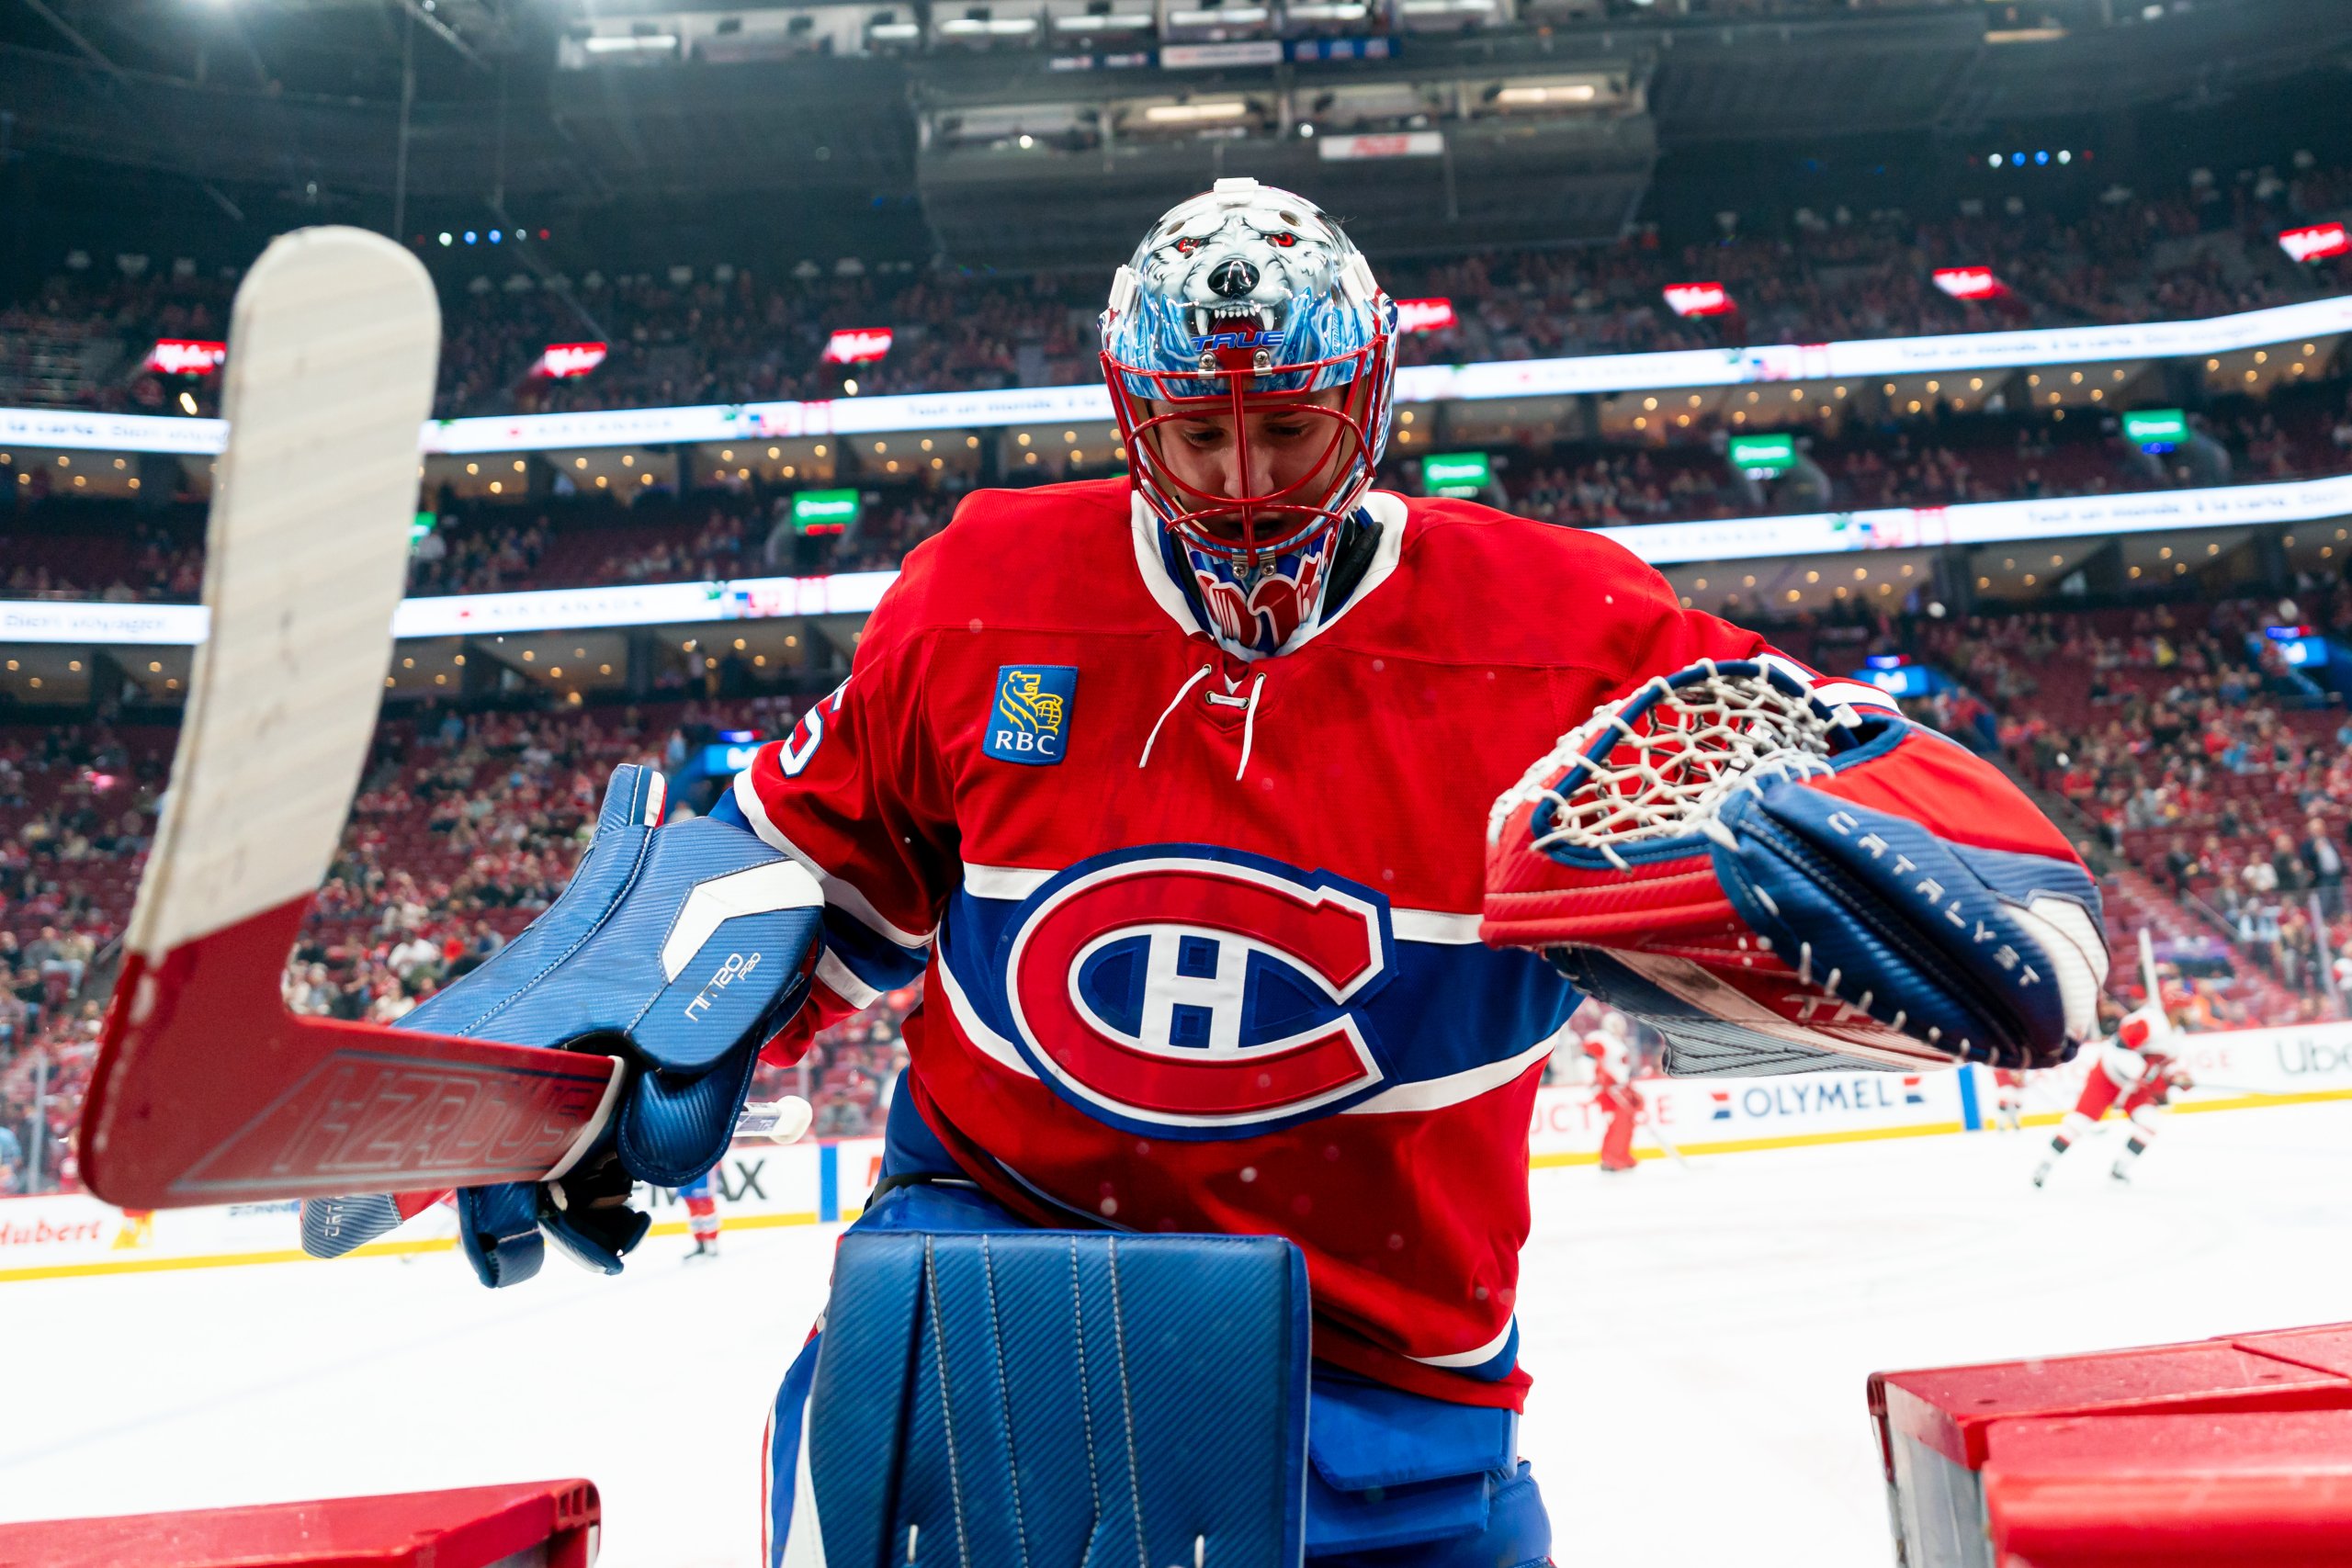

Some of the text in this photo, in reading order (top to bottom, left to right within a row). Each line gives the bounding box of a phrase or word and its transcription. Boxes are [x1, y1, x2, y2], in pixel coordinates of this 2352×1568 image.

[1190, 331, 1285, 352] TRUE
[995, 730, 1057, 756] RBC
[1826, 810, 2041, 987] CATALYST
[684, 952, 762, 1022] NITRO PRO
[1743, 1078, 1894, 1119] OLYMEL
